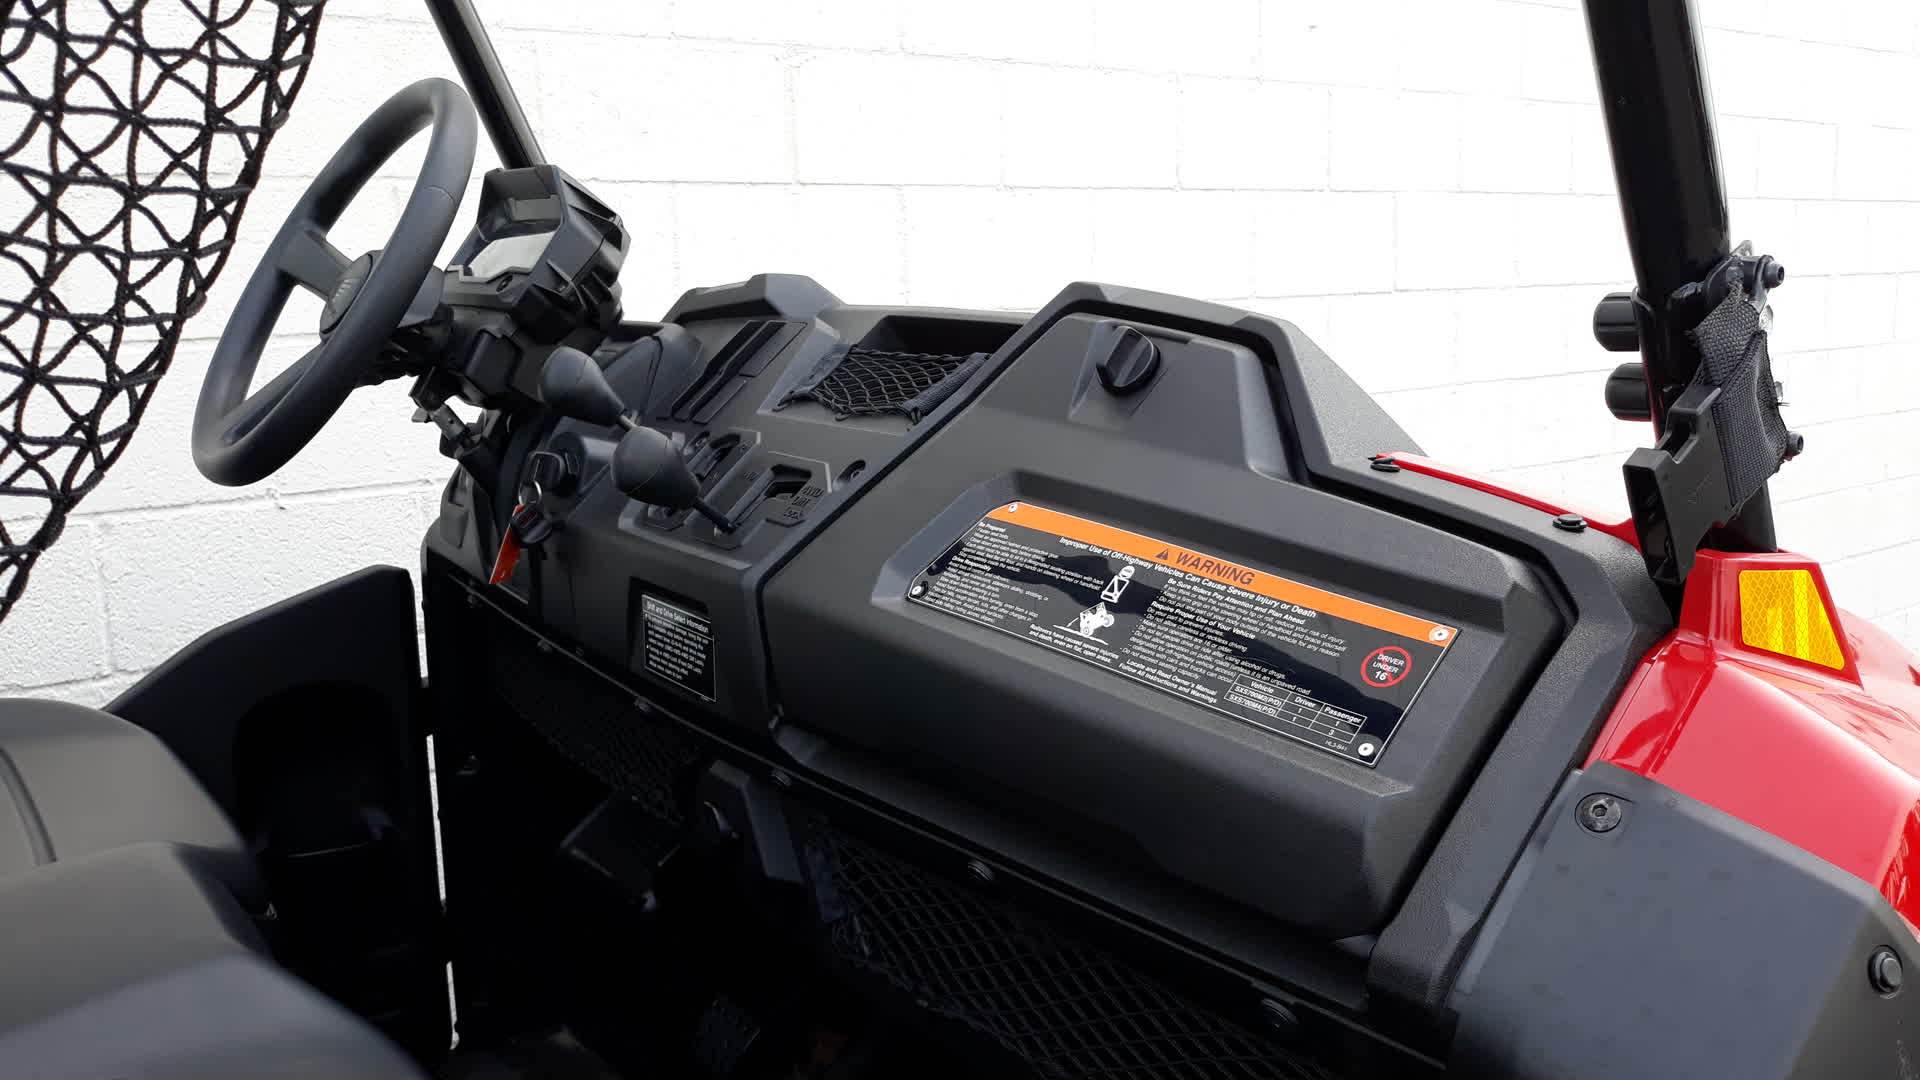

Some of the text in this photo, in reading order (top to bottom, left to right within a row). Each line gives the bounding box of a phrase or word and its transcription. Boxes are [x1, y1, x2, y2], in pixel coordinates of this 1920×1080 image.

[1056, 536, 1090, 551] Improper
[1086, 544, 1104, 554] Use
[1101, 548, 1112, 556] of
[1108, 551, 1154, 570] Off-Highway
[1151, 563, 1186, 578] Vehicles
[1182, 572, 1202, 583] Can
[1199, 577, 1228, 591] Cause
[1225, 585, 1257, 600] Severe
[1253, 594, 1281, 608] Injury
[1278, 602, 1292, 610] or
[1289, 604, 1318, 618] Death
[1176, 551, 1255, 585] WARNING
[1148, 600, 1176, 613] Require
[1172, 608, 1197, 620] Proper
[1193, 615, 1210, 624] Use
[1214, 621, 1233, 631] Your
[1229, 626, 1257, 639] Vehicle
[1166, 577, 1306, 625] Be Sure Riders Pay Attention and Plan Ahead
[1174, 601, 1186, 609] put
[1182, 604, 1196, 612] any
[1193, 607, 1207, 615] part
[1210, 613, 1226, 622] your
[1223, 617, 1240, 626] body
[1237, 621, 1261, 632] outside
[1275, 633, 1299, 644] vehicle
[1304, 643, 1319, 651] any
[1124, 658, 1219, 696] Locate and Read Owner's Manual
[1371, 660, 1400, 674] UNDER
[1371, 669, 1389, 681] 16
[1375, 653, 1406, 667] DRIVER
[1117, 662, 1139, 673] Follow
[1143, 672, 1180, 689] Instructions
[1176, 684, 1191, 693] and
[1187, 688, 1219, 704] Warnings
[1232, 685, 1283, 707] SXS700M2(P/D)
[1248, 680, 1362, 725] Vehicle Driver Passenger
[1326, 728, 1335, 736] 3
